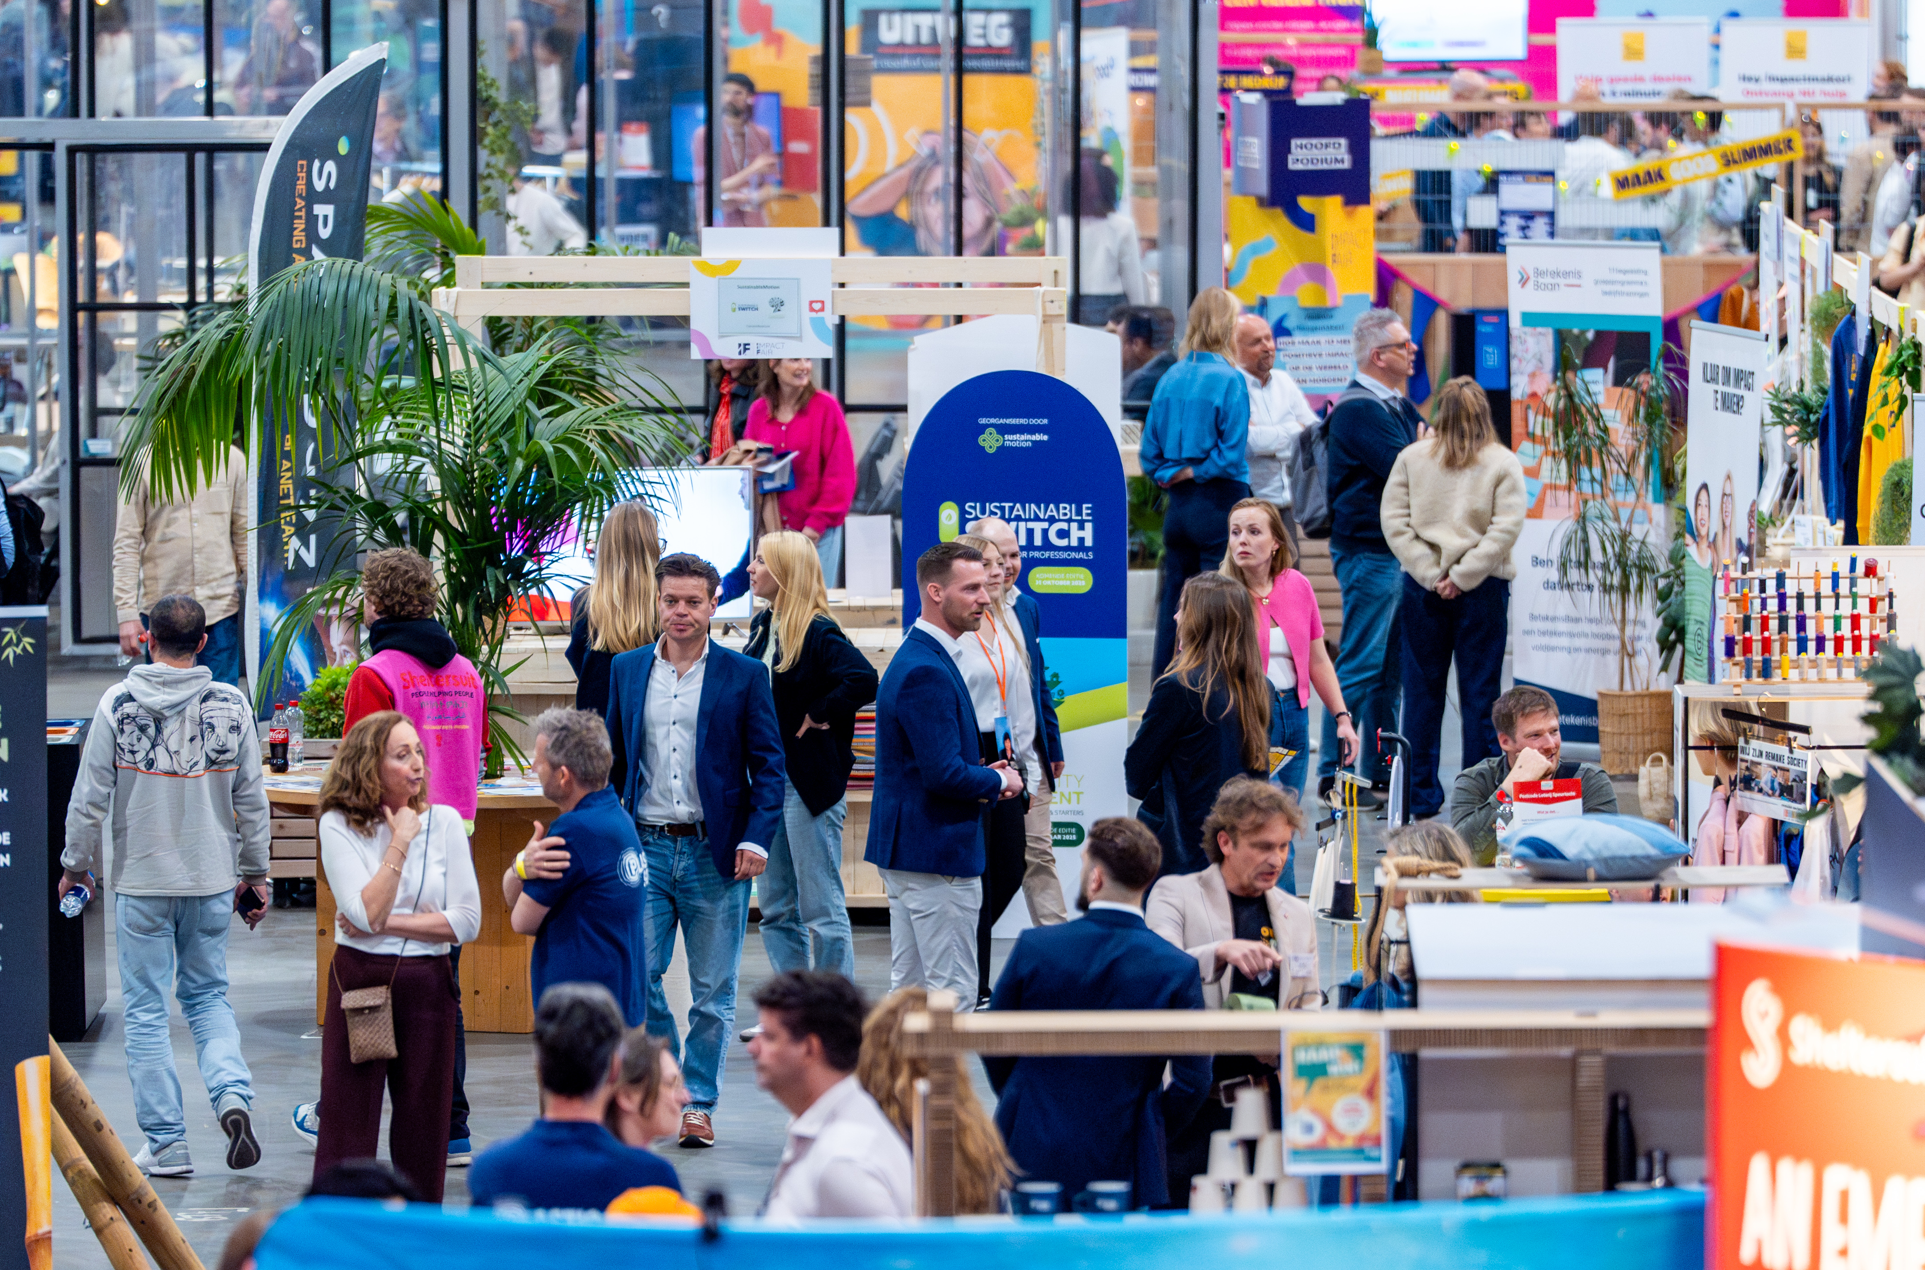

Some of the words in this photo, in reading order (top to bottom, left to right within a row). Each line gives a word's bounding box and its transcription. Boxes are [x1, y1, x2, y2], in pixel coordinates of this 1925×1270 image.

[1614, 166, 1665, 191] MAAK
[292, 159, 308, 249] CREATING
[1532, 267, 1582, 279] Betekenis
[1532, 280, 1560, 291] Baan
[756, 342, 786, 350] IMPACT
[1702, 361, 1720, 386] KLAAR
[1721, 365, 1731, 388] OM
[1732, 367, 1755, 392] IMPACT
[977, 417, 1028, 425] GEORGANISEERD
[1004, 432, 1049, 441] sustainable
[964, 502, 1093, 520] SUSTAINABLE
[1029, 550, 1094, 560] PROFESSIONALS
[1531, 554, 1553, 569] Ben
[1740, 745, 1751, 757] WIJ
[1751, 748, 1763, 759] ZIJN
[1764, 751, 1785, 764] REMAKE
[1786, 756, 1808, 769] SOCIETY
